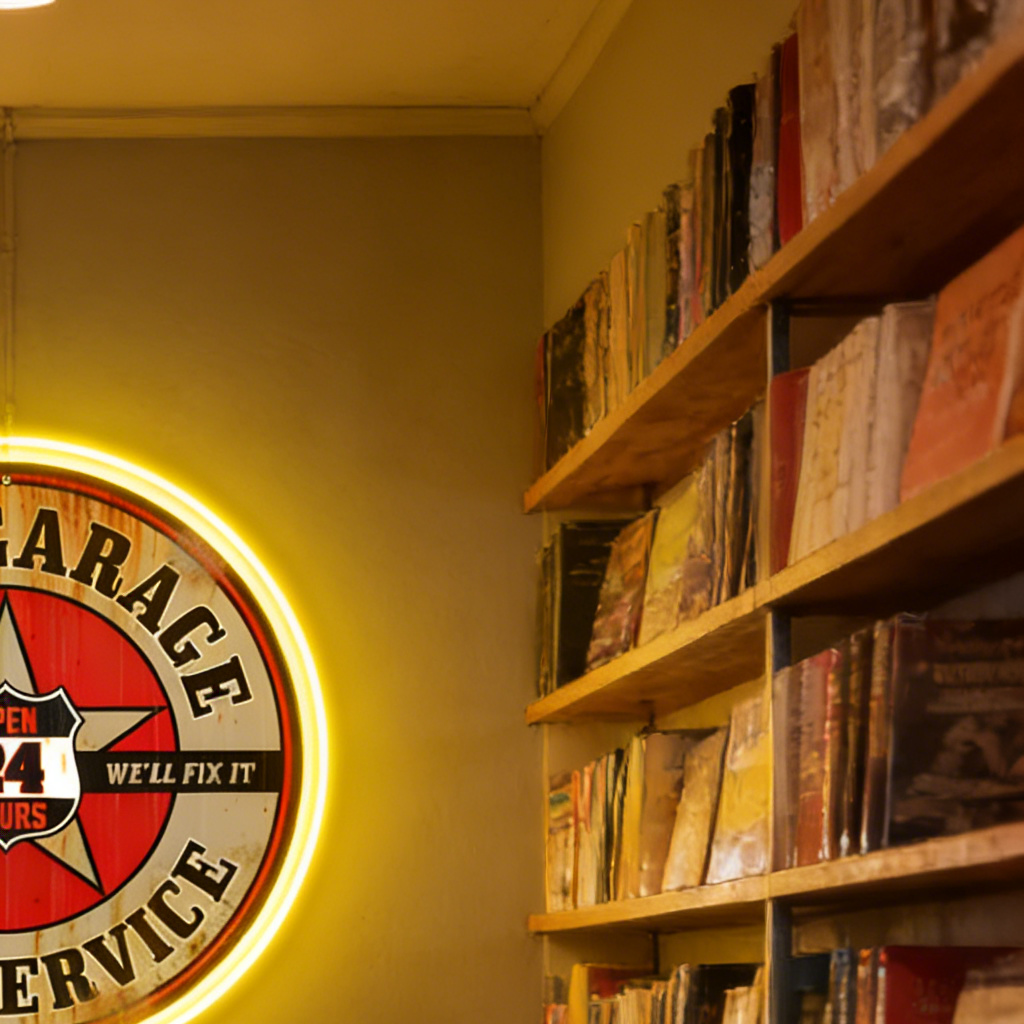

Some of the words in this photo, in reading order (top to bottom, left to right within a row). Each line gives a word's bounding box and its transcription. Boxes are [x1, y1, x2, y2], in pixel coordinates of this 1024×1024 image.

[106, 762, 177, 785] WE'LL
[182, 762, 224, 785] FIX
[228, 762, 256, 784] IT
